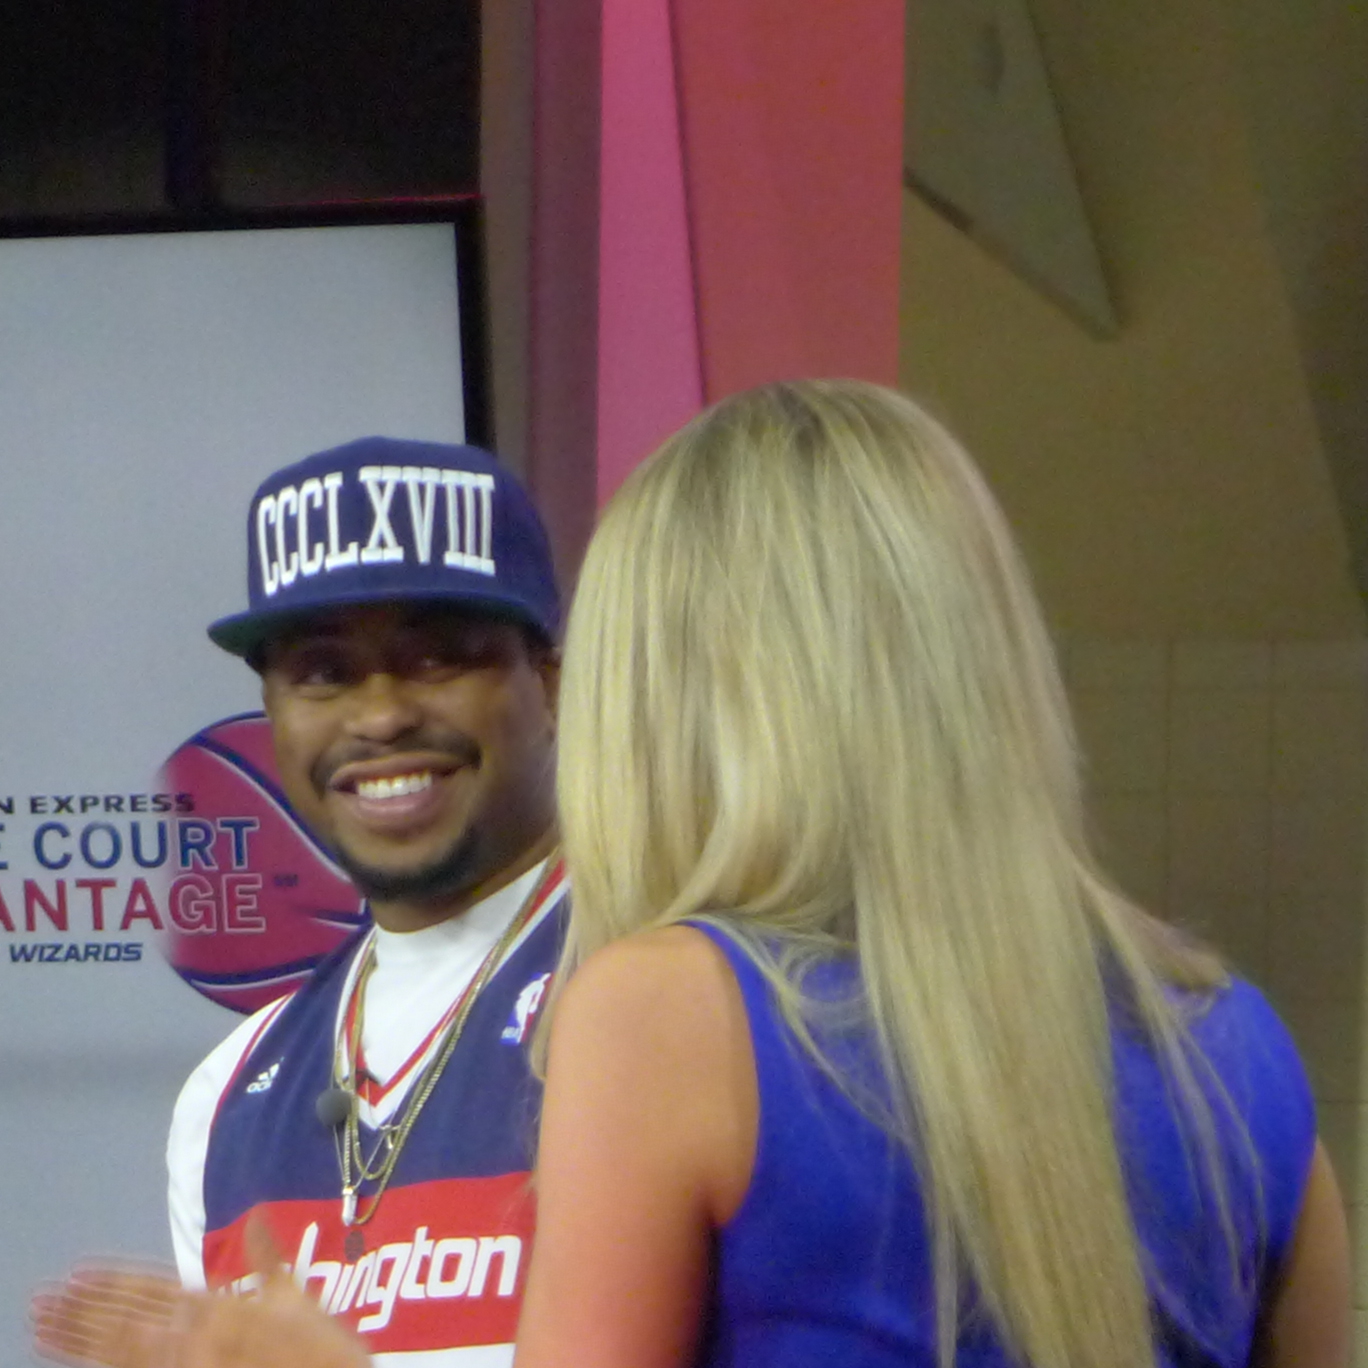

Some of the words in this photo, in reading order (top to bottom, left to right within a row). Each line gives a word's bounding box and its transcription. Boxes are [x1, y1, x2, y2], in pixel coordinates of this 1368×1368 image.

[257, 465, 496, 597] CCCLXVIII
[29, 793, 195, 815] EXPRESS
[33, 817, 260, 871] COURT
[9, 942, 143, 963] WIZARDS
[218, 1221, 522, 1333] hington
